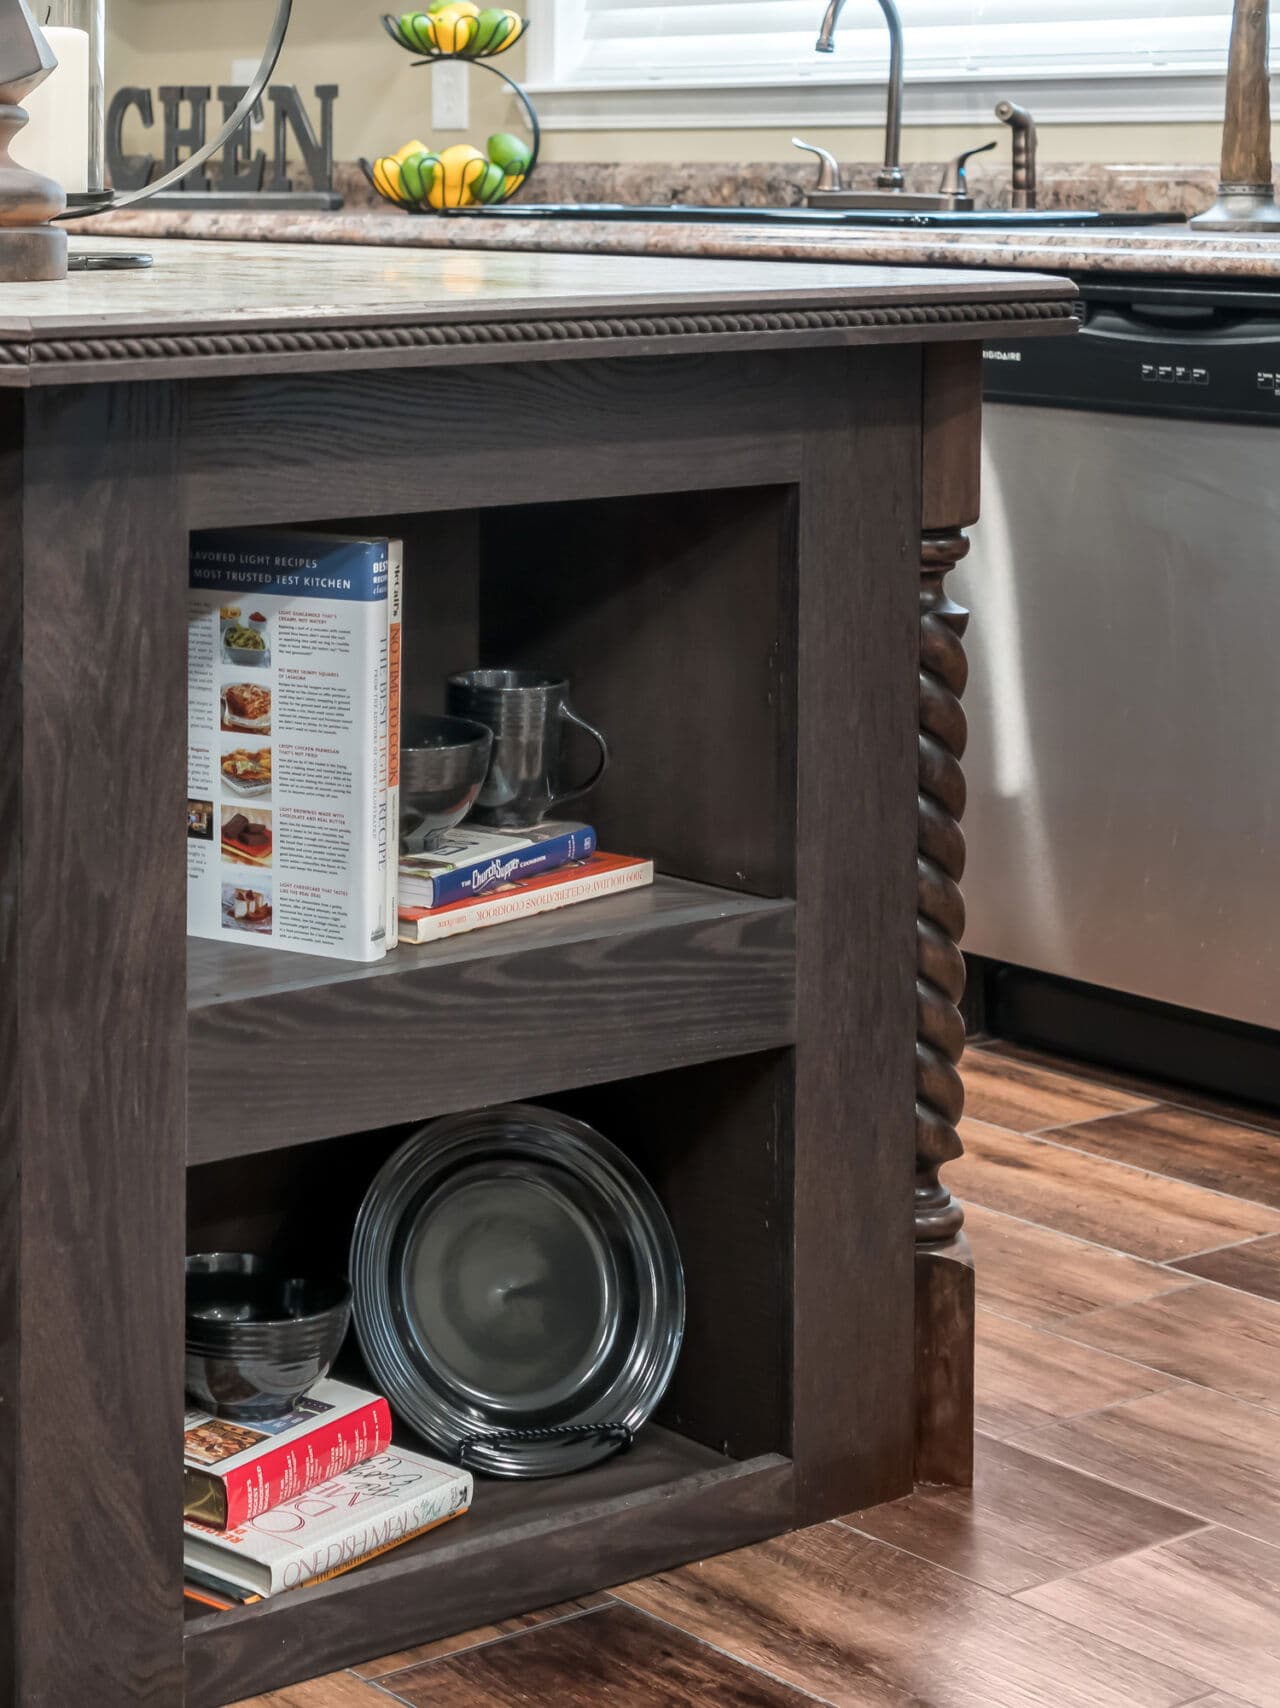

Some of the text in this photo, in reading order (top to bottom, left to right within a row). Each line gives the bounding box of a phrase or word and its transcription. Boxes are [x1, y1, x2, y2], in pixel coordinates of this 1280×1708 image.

[240, 554, 271, 566] LIGHT
[275, 557, 318, 570] RECIPES
[226, 571, 273, 584] TRUSTED
[276, 575, 300, 586] TEST
[304, 577, 352, 590] KITCHEN
[390, 627, 400, 654] NO
[390, 661, 400, 698] TIME
[389, 706, 399, 725] TO
[389, 732, 399, 784] COOK
[378, 801, 387, 872] RECIPE
[472, 861, 497, 890] Church
[495, 857, 520, 881] Supper
[474, 899, 525, 921] COOKBOOK
[325, 1529, 367, 1569] DISH
[368, 1505, 420, 1550] MEALS
